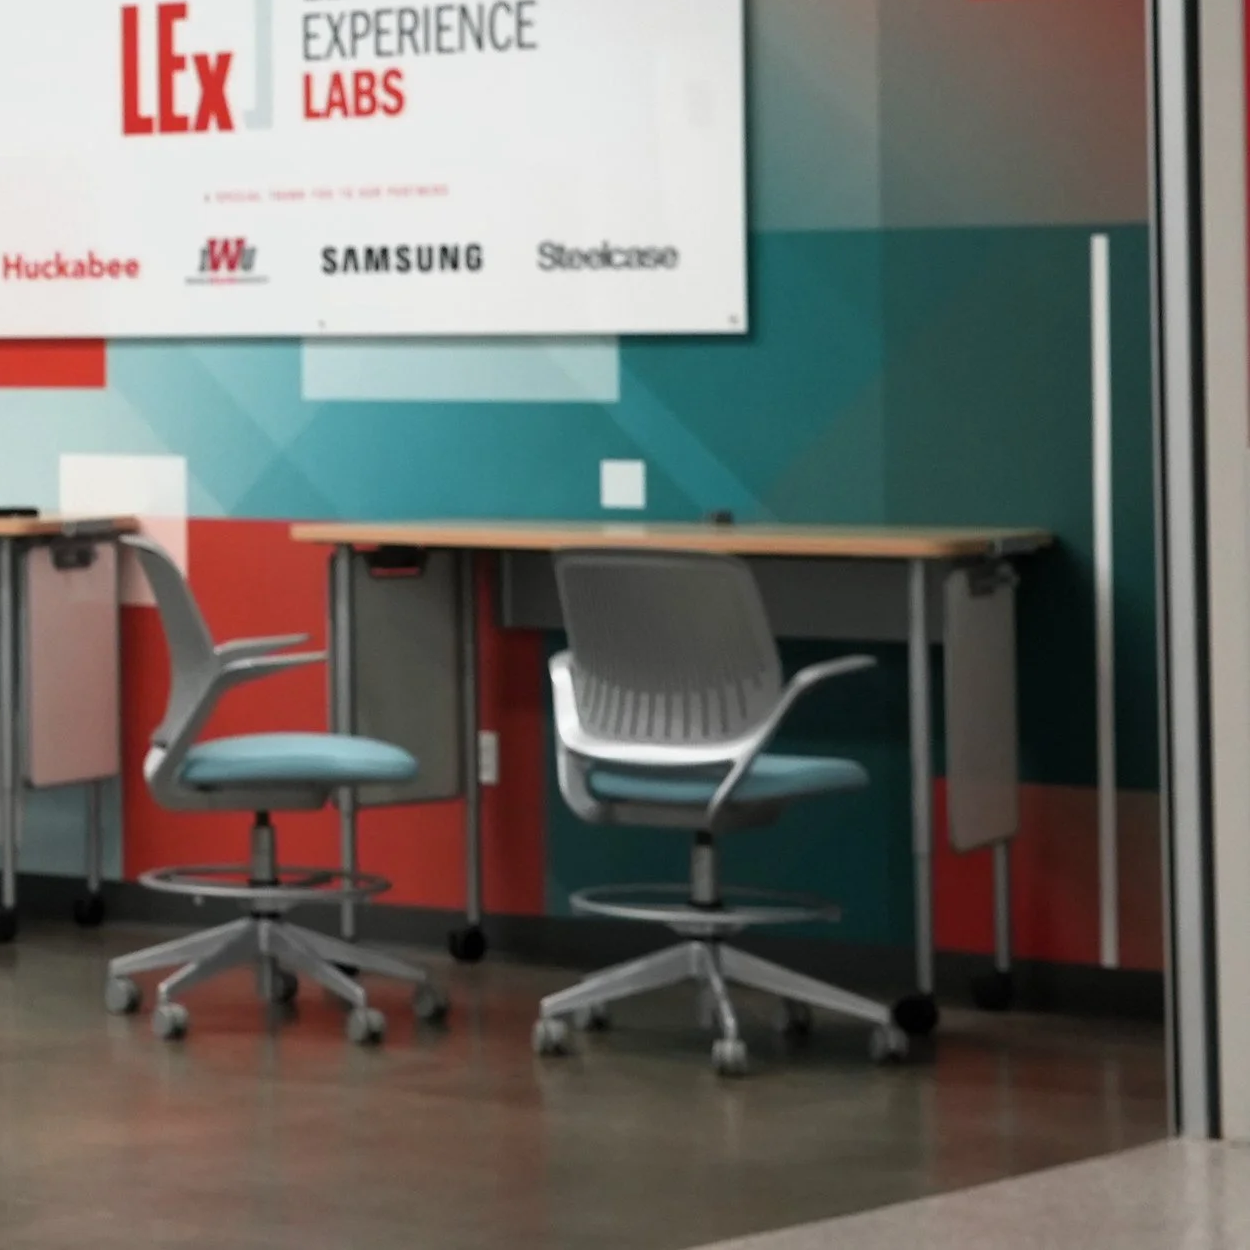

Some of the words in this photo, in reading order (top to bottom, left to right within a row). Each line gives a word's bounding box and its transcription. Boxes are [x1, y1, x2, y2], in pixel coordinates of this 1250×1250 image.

[301, 0, 538, 62] EXPERIENCE
[120, 0, 236, 137] LEx
[301, 67, 406, 121] LABS
[1, 251, 141, 281] Huckabee
[321, 242, 484, 276] SAMSUNG
[537, 239, 680, 272] Steelcase
